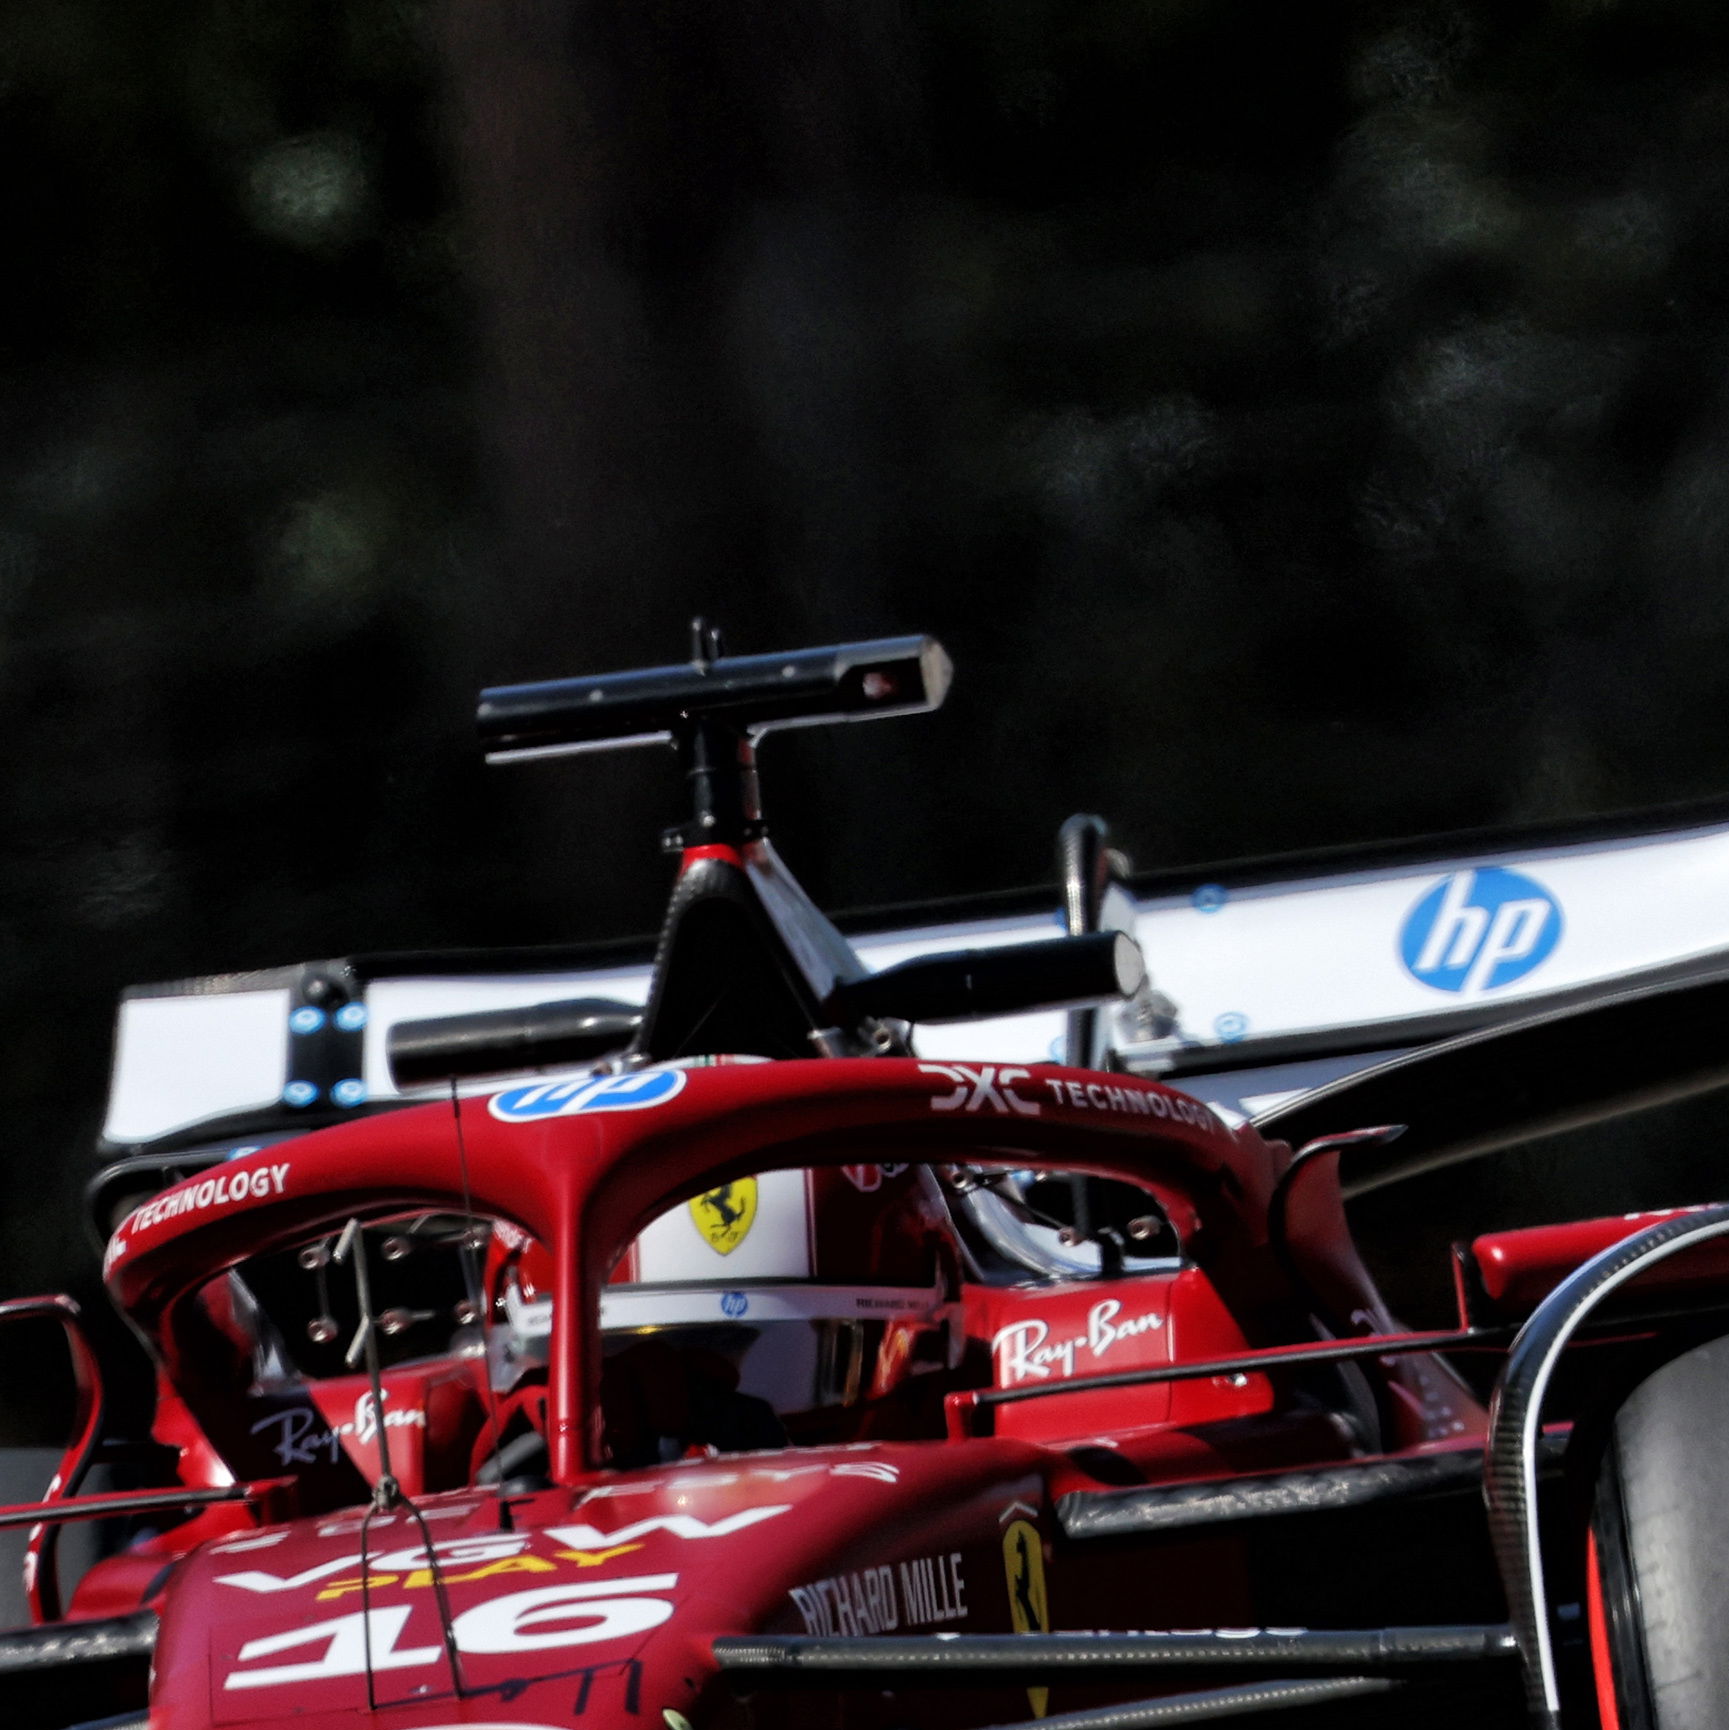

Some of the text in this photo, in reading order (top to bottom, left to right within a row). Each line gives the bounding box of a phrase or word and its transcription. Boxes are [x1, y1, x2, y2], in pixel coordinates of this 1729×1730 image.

[1410, 867, 1554, 995] hp
[917, 1063, 1216, 1135] DXC TECHNOLOGY
[131, 1163, 290, 1235] TECHNOLOGY
[722, 1291, 747, 1317] hp
[991, 1298, 1163, 1377] Ray-Ban
[250, 1387, 426, 1466] Ray-Ban
[214, 1504, 794, 1594] VGW
[316, 1543, 645, 1601] PLAY
[223, 1572, 680, 1690] 16
[788, 1553, 969, 1636] RICHARD MILLE
